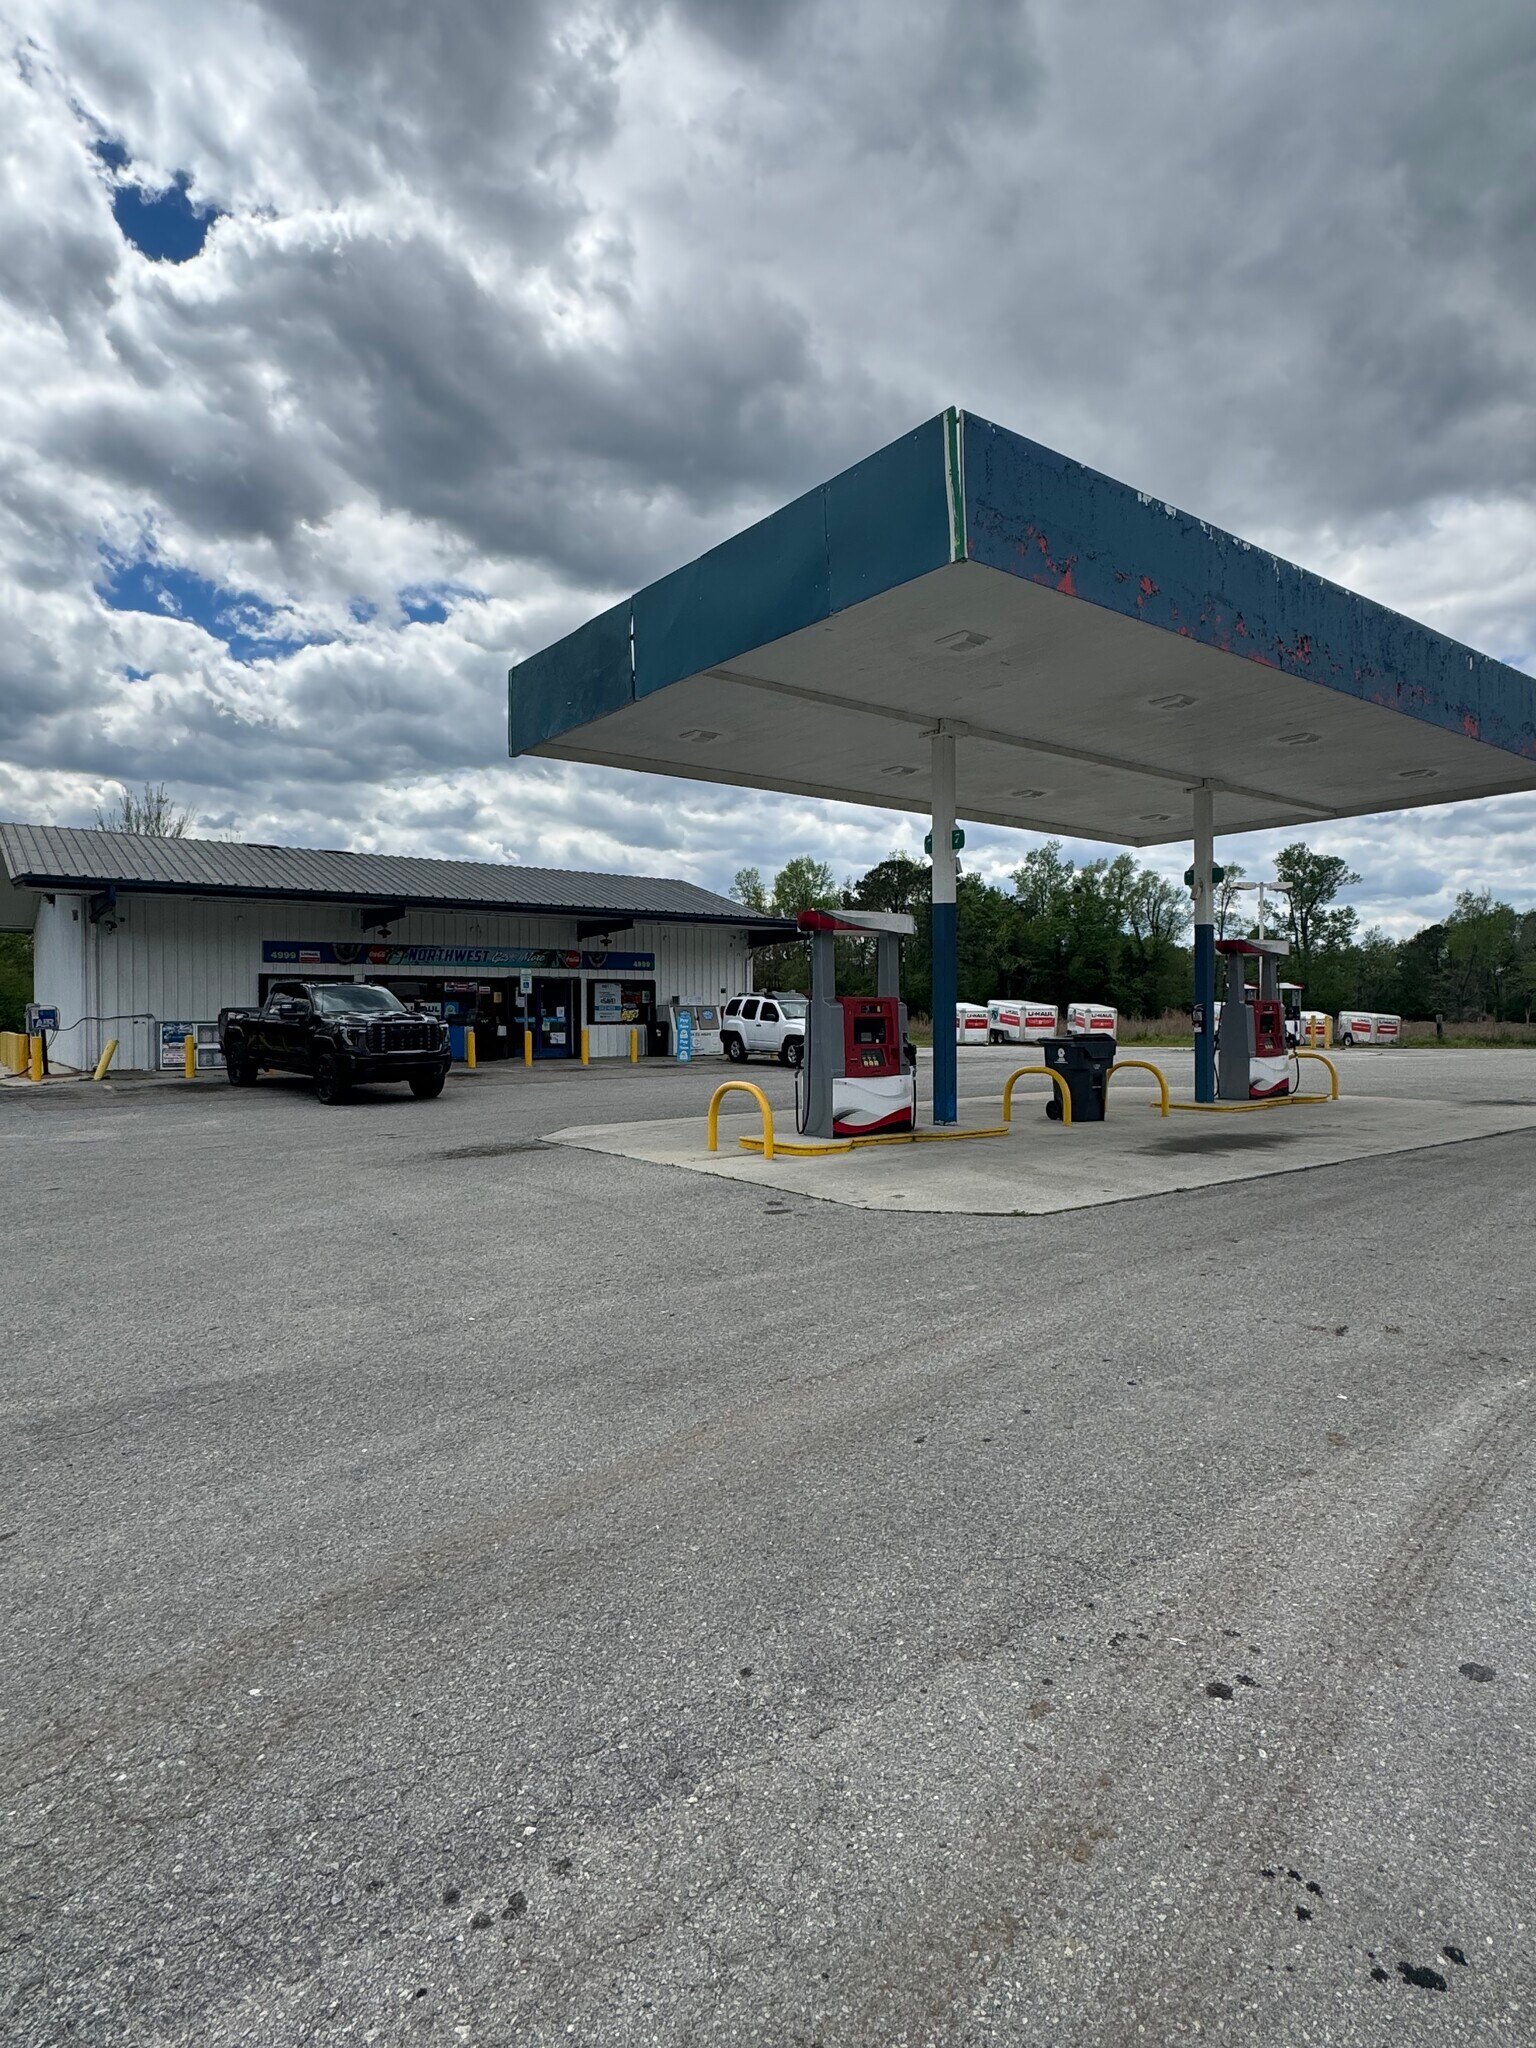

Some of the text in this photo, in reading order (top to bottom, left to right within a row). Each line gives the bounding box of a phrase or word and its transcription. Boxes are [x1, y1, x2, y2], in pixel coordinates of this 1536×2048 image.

[954, 833, 960, 844] 7
[270, 951, 297, 960] 4999
[408, 947, 490, 962] NORTHWEST
[35, 1018, 55, 1028] AIR
